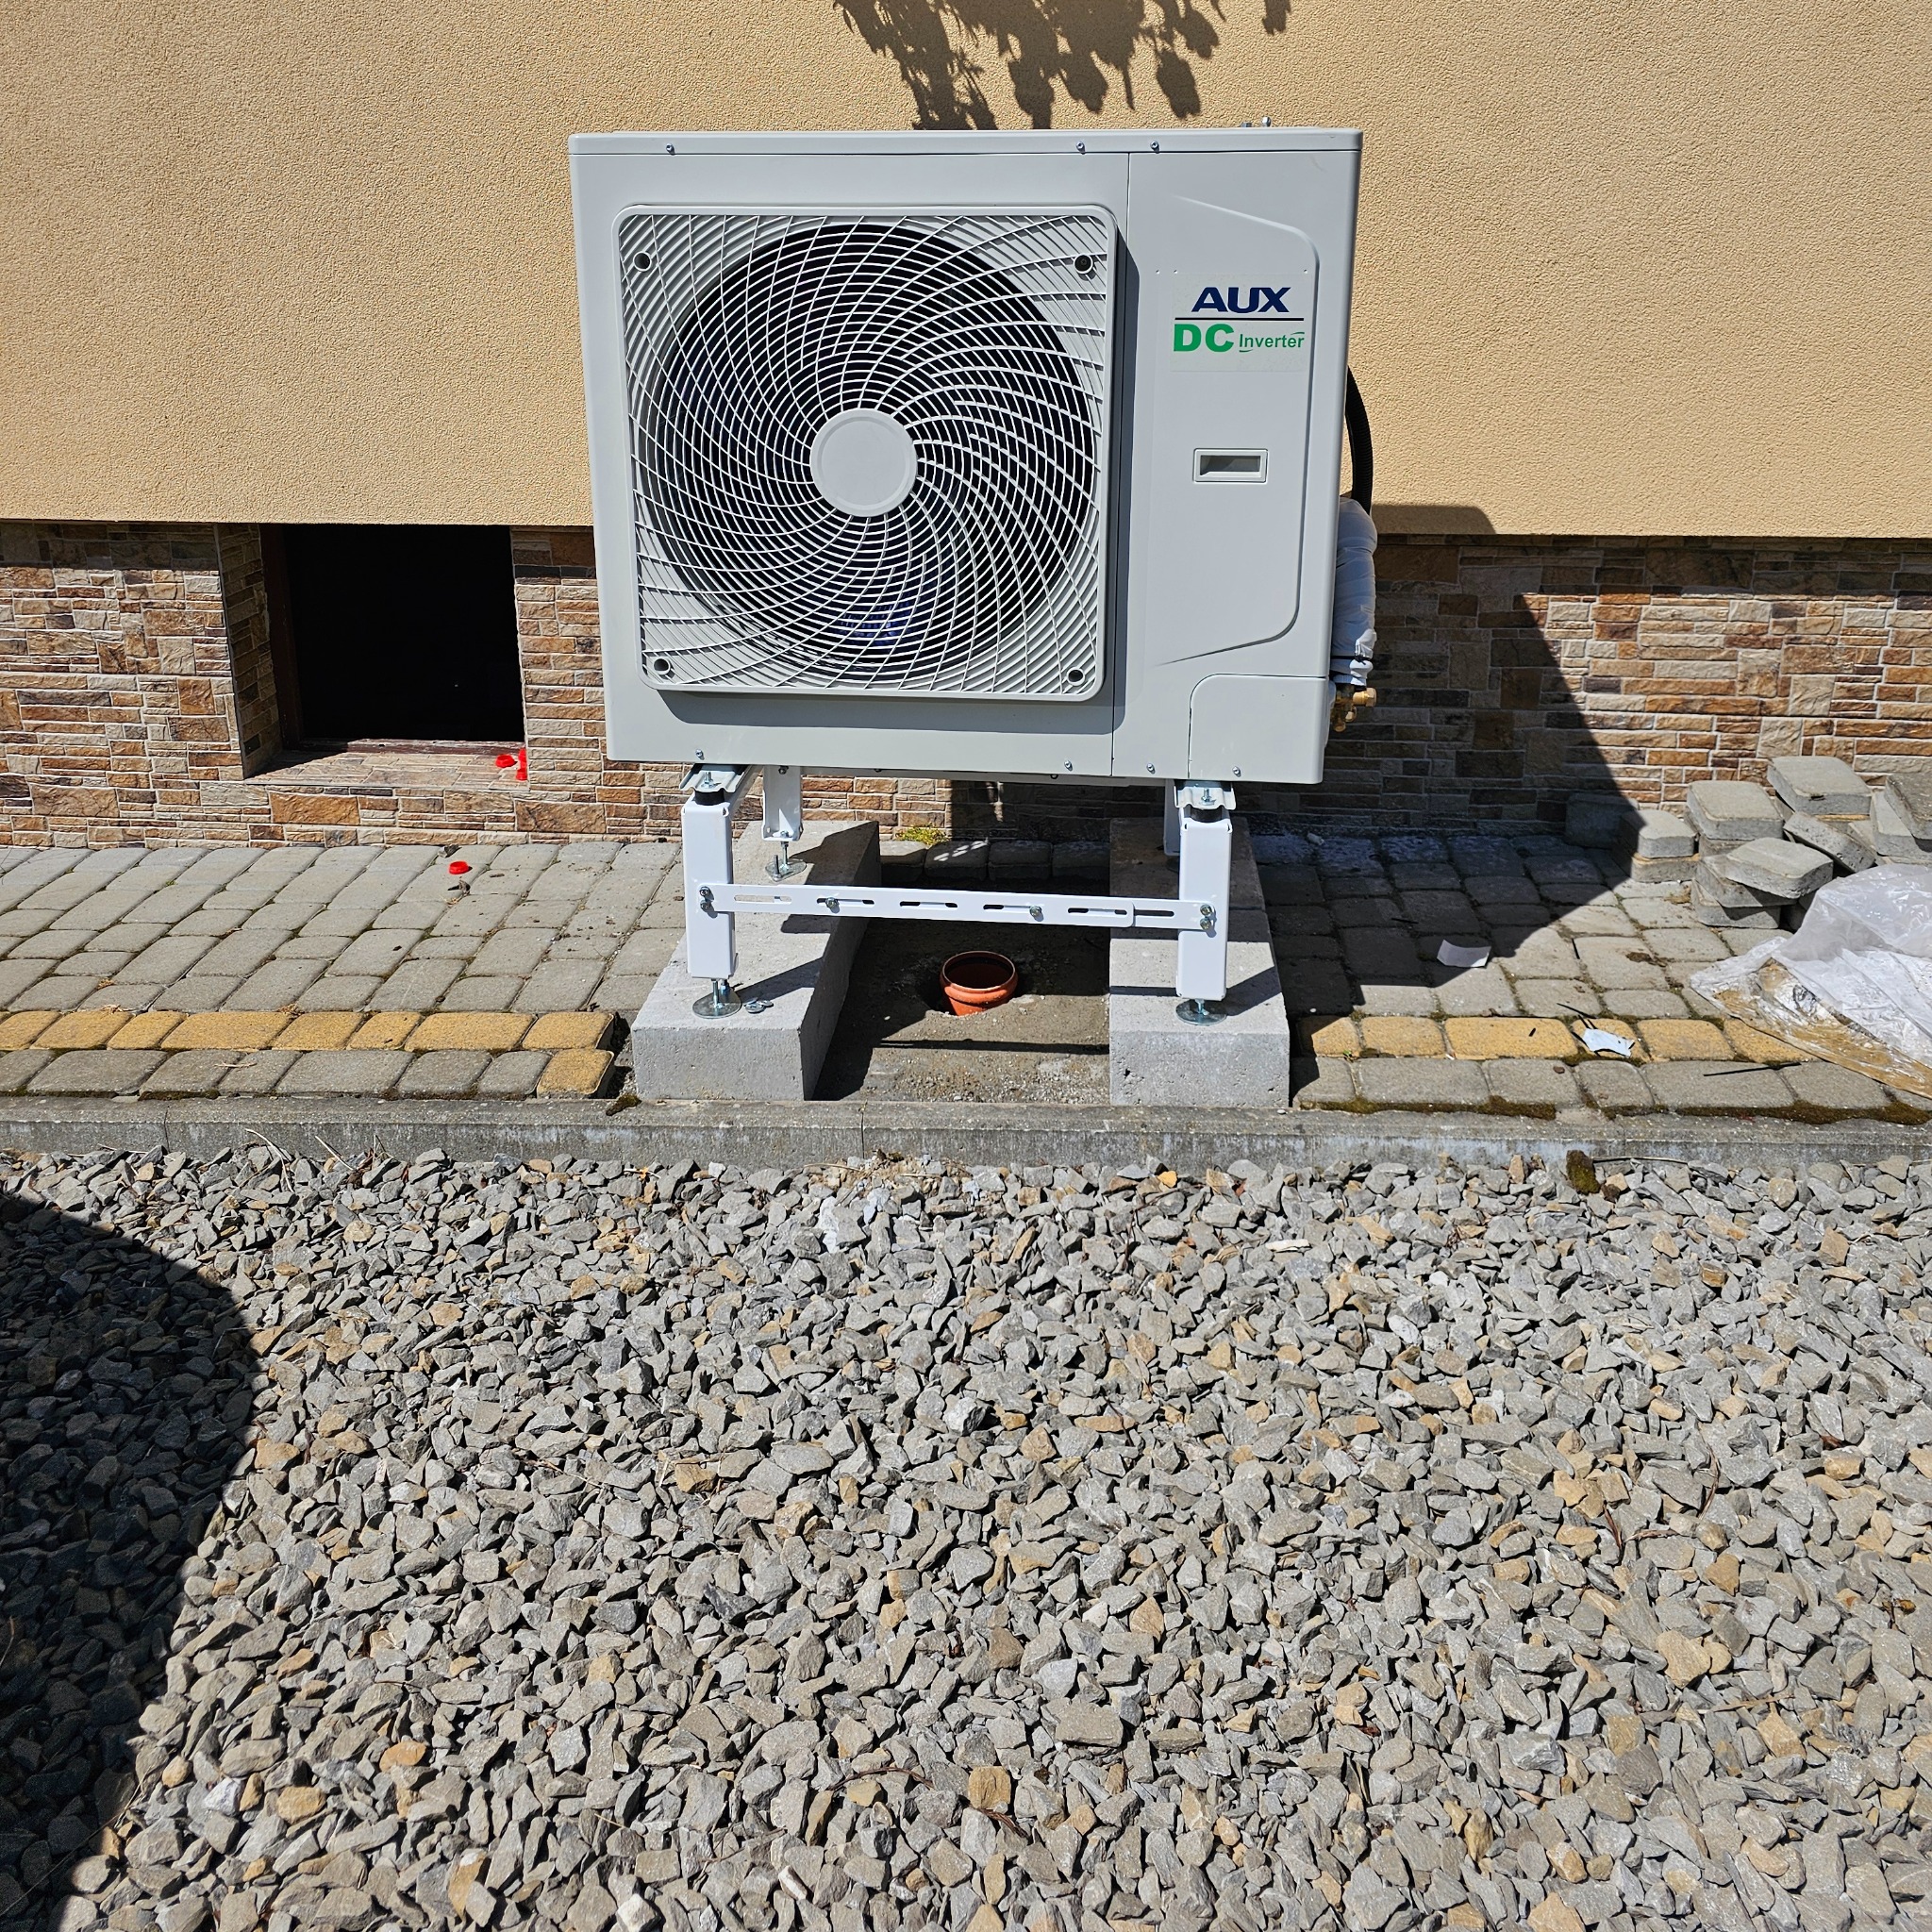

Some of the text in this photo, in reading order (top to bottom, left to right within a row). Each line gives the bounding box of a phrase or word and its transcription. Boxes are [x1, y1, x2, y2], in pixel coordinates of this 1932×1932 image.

[1191, 287, 1291, 313] AUX
[1174, 323, 1305, 353] DC Inverter
